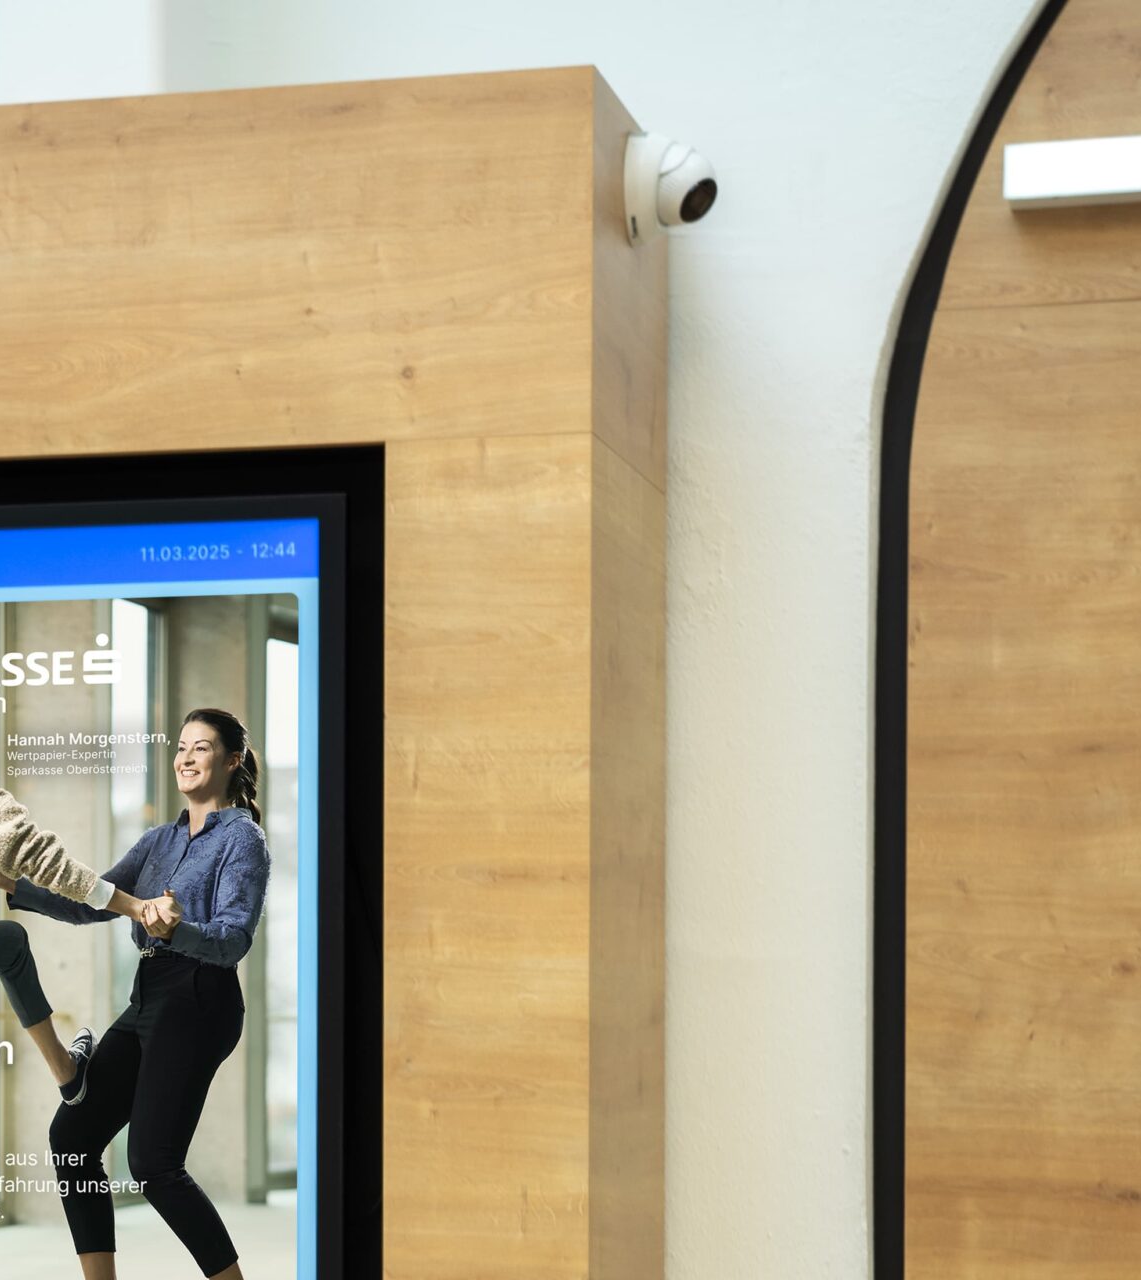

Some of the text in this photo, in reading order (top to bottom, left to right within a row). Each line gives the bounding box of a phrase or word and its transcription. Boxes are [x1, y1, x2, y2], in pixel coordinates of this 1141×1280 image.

[140, 544, 230, 562] 11.03.2025
[251, 541, 296, 559] 12:44
[7, 732, 171, 748] Hannah Morgenstern,
[7, 748, 117, 763] Wertpapier-Expertin
[7, 763, 148, 778] Sparkasse Oberösterreich
[5, 1151, 38, 1167] aus
[44, 1151, 87, 1167] Ihrer
[76, 1178, 148, 1194] unserer
